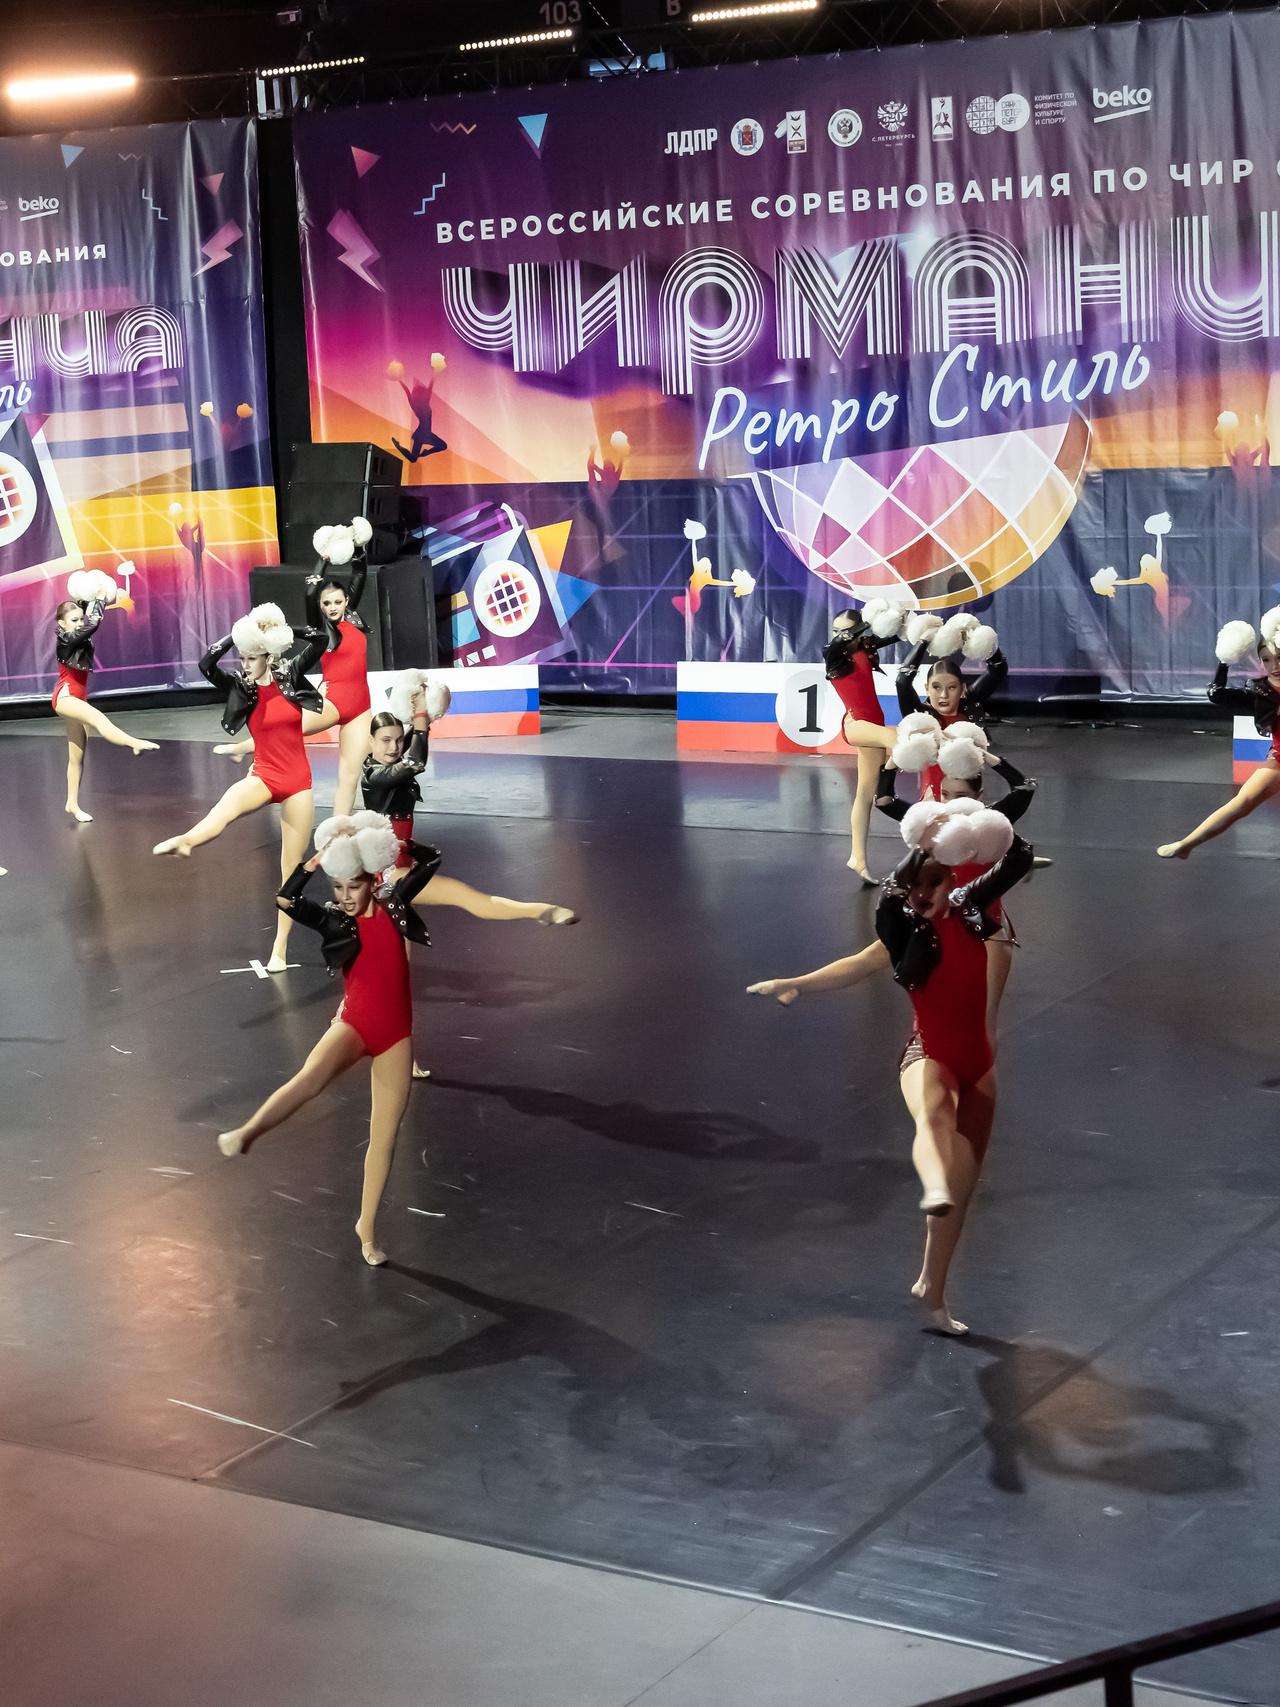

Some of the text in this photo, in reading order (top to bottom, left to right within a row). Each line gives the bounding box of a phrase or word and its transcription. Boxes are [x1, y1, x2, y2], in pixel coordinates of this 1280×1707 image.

[539, 1, 582, 25] 103
[1034, 93, 1063, 102] КОМИТЕТ
[1034, 99, 1078, 110] ФИЗИЧЕСКОЙ
[1092, 85, 1152, 109] beko
[1034, 109, 1064, 118] КУЛЬТУРЕ
[1041, 117, 1066, 125] СПОРТУ
[664, 128, 718, 157] ЛДПР
[18, 195, 60, 212] beko
[436, 199, 733, 244] ВСЕРОССИЙСКИЕ
[751, 172, 1070, 219] СОРЕВНОВАНИЯ
[1093, 167, 1148, 194] ПО
[1170, 158, 1253, 187] ЧИР
[698, 342, 1151, 471] Ретро Стиль
[798, 684, 824, 732] 1
